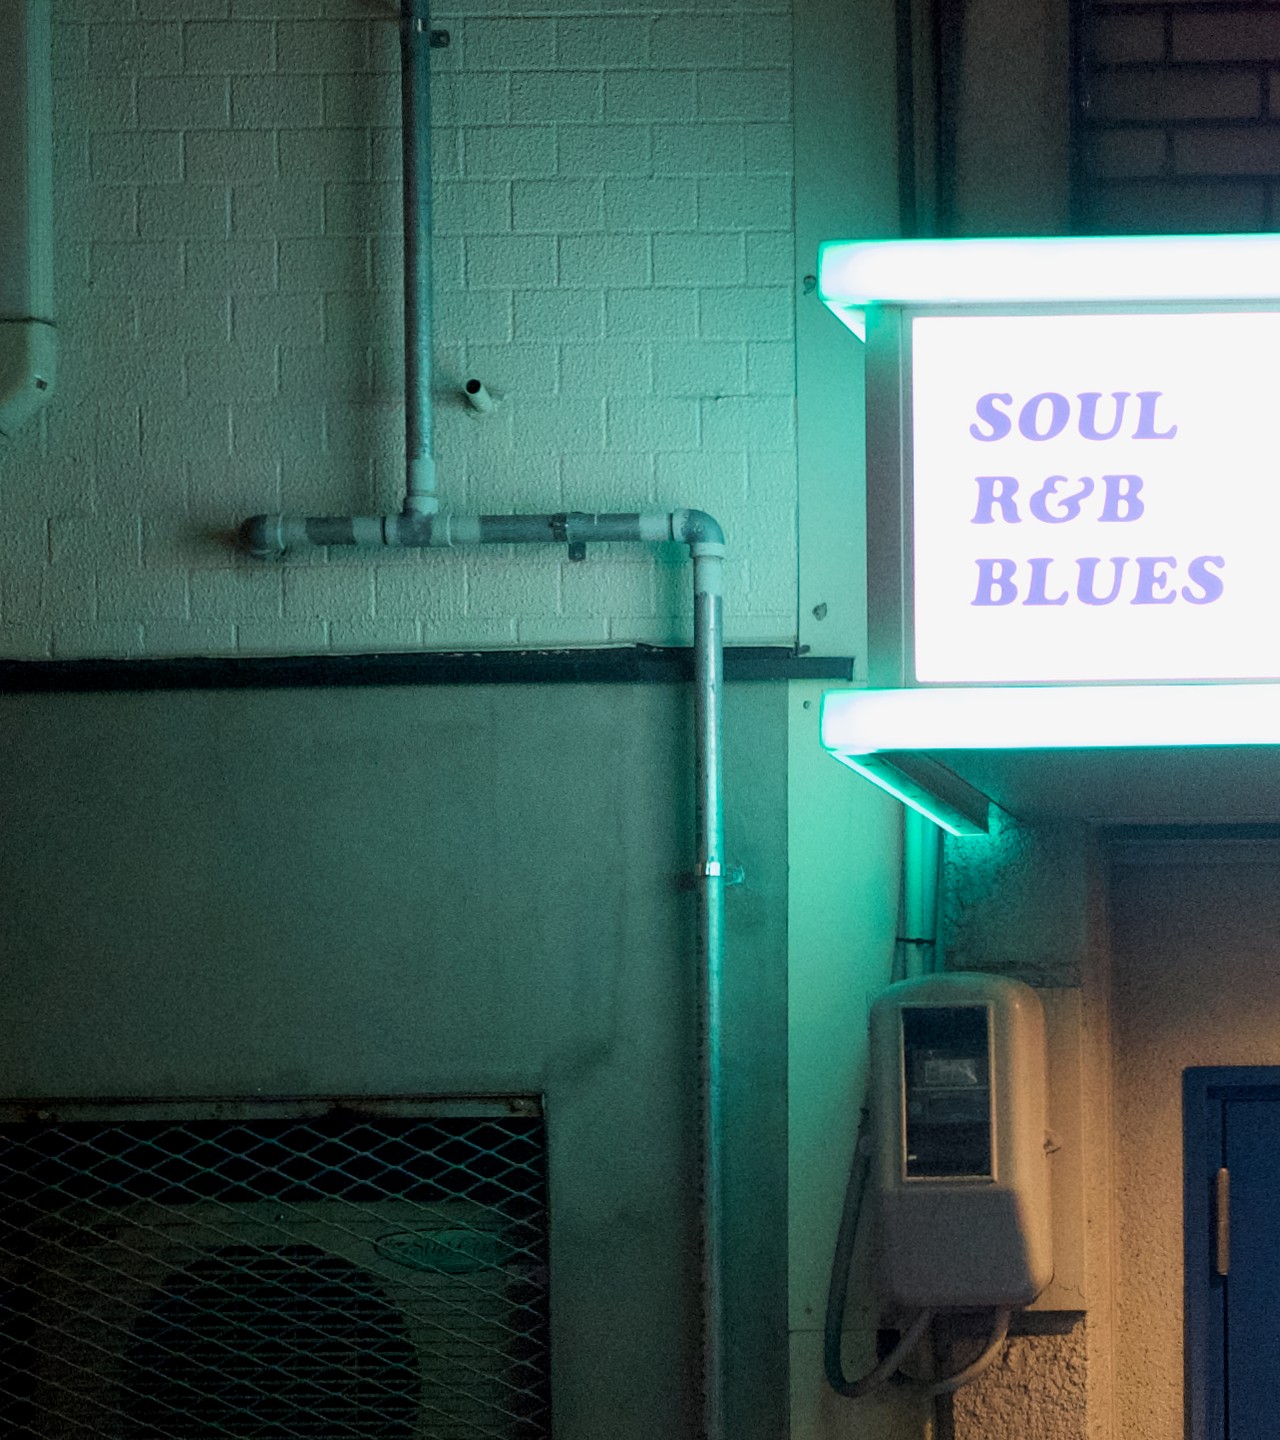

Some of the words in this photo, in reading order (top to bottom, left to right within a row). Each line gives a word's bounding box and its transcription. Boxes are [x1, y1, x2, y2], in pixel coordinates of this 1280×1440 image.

[968, 391, 1179, 442] SOUL
[969, 474, 1147, 525] R&B
[969, 554, 1226, 607] BLUES
